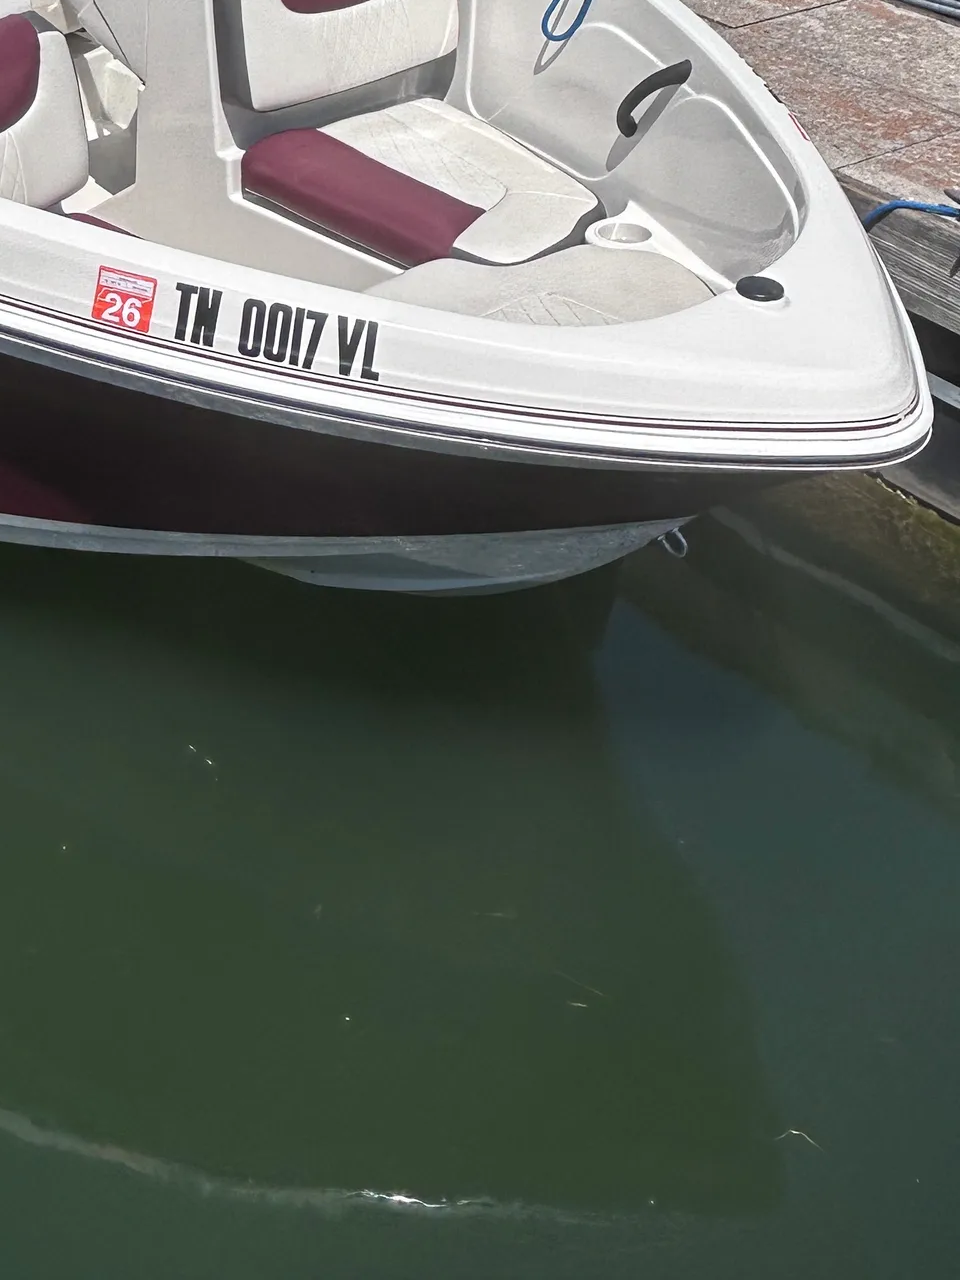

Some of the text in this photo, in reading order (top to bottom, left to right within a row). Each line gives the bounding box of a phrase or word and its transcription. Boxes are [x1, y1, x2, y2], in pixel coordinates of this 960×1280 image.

[101, 292, 143, 328] 26
[174, 282, 380, 381] TN 0017 VL
